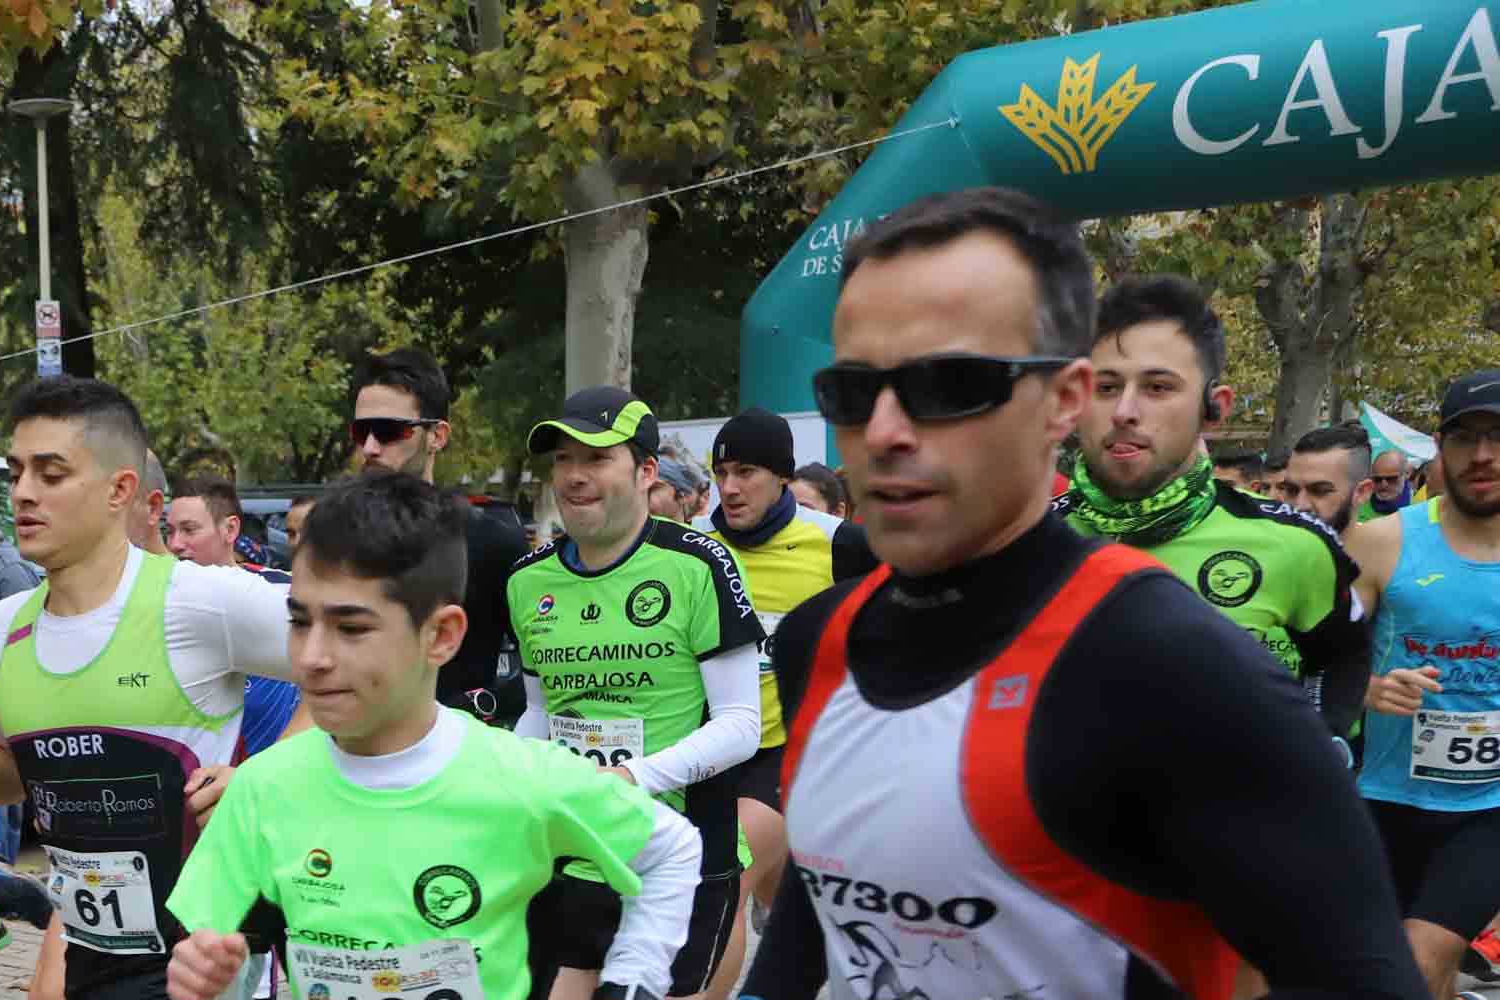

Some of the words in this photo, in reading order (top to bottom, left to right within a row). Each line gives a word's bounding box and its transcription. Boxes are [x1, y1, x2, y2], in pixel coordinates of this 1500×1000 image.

[1172, 7, 1500, 159] CAJA
[681, 532, 752, 618] CARBAJOSA
[531, 641, 676, 665] CORRECAMINOS
[542, 671, 654, 690] CARBAJOSA
[34, 733, 105, 759] ROBER
[1446, 736, 1500, 765] 58
[101, 789, 156, 825] Ramos
[74, 888, 124, 928] 61
[310, 950, 346, 969] Vuelta
[346, 952, 401, 971] Pedestre
